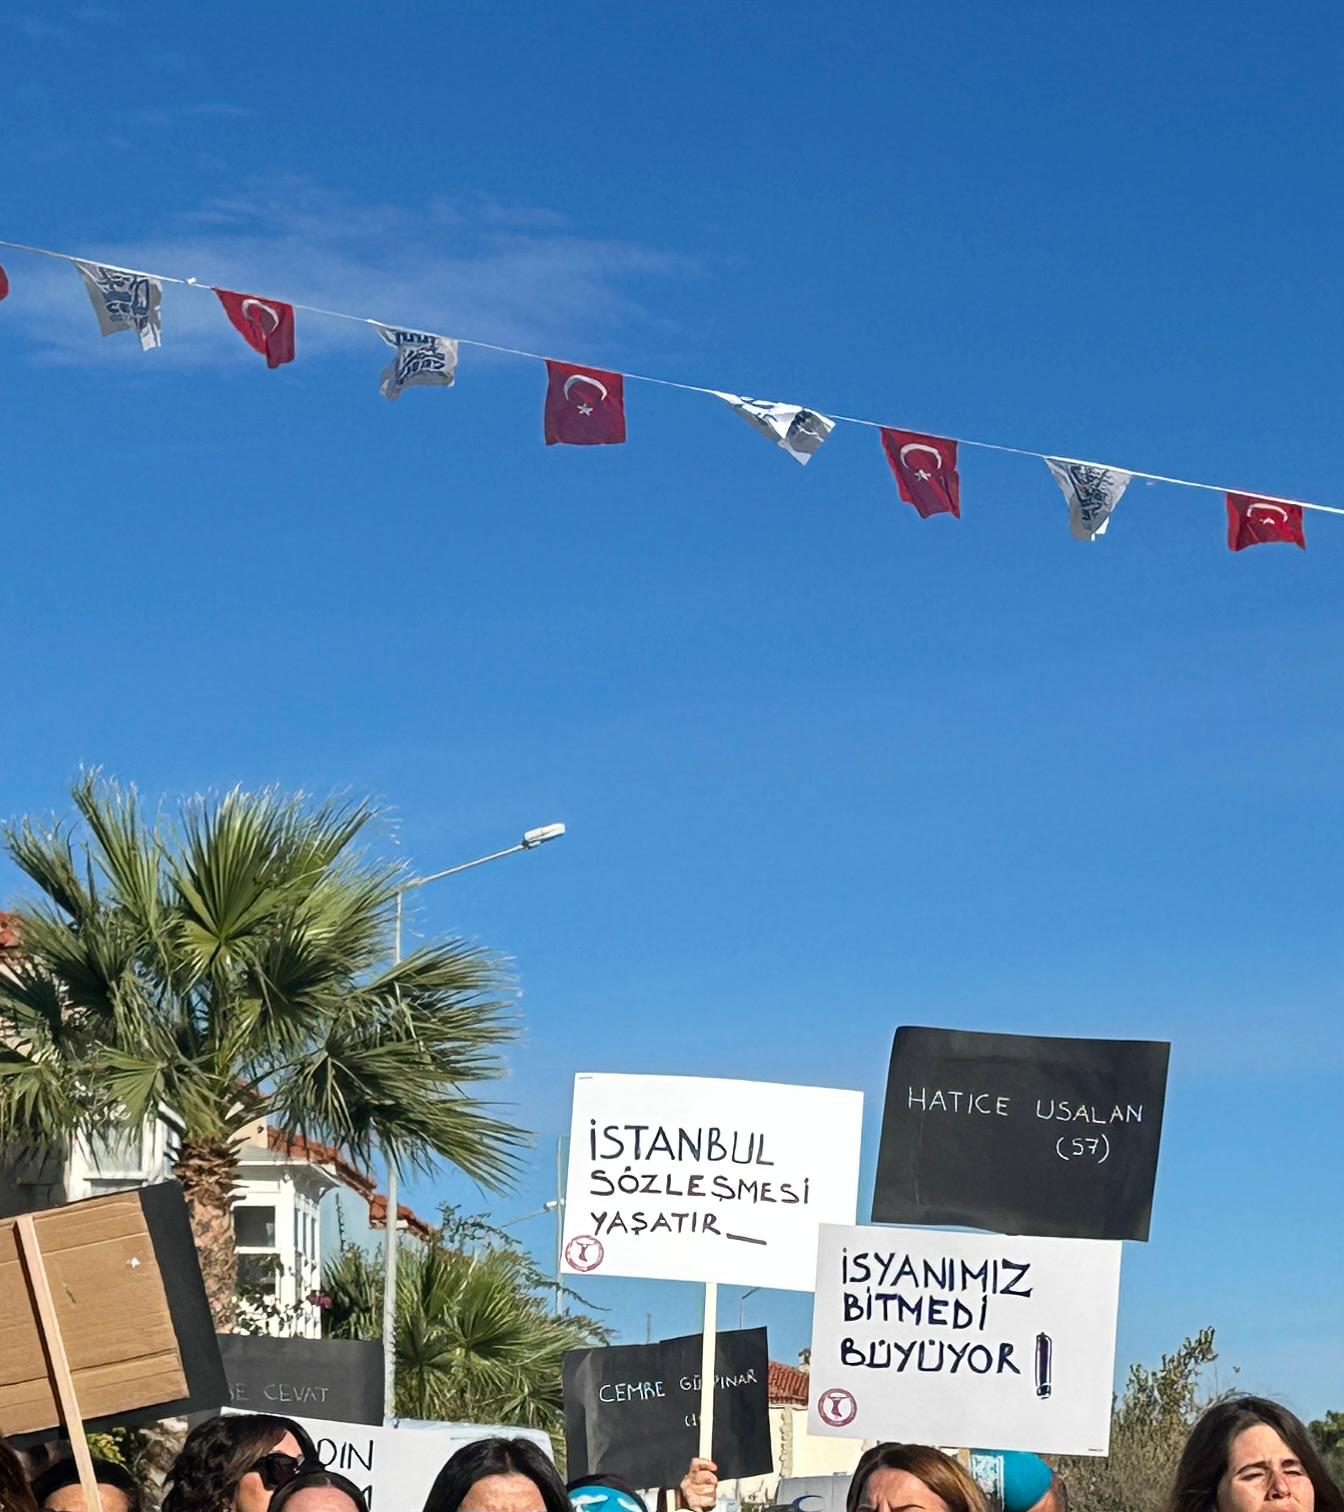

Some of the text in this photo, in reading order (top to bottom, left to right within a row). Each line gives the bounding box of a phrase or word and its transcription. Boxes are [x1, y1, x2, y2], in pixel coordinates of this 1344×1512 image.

[908, 1086, 1143, 1125] HATICE USALAN
[589, 1119, 775, 1167] İSTANBUL
[1055, 1133, 1110, 1164] (57)
[589, 1165, 810, 1205] SÖZLEŞMESİ
[589, 1211, 722, 1239] YAŞATIR
[841, 1247, 1033, 1300] İSYANIMIZ
[842, 1293, 988, 1331] BİTMEDİ
[840, 1335, 1022, 1375] BÜYÜYOR
[263, 1383, 329, 1402] CEVAT
[316, 1437, 374, 1472] DIN
